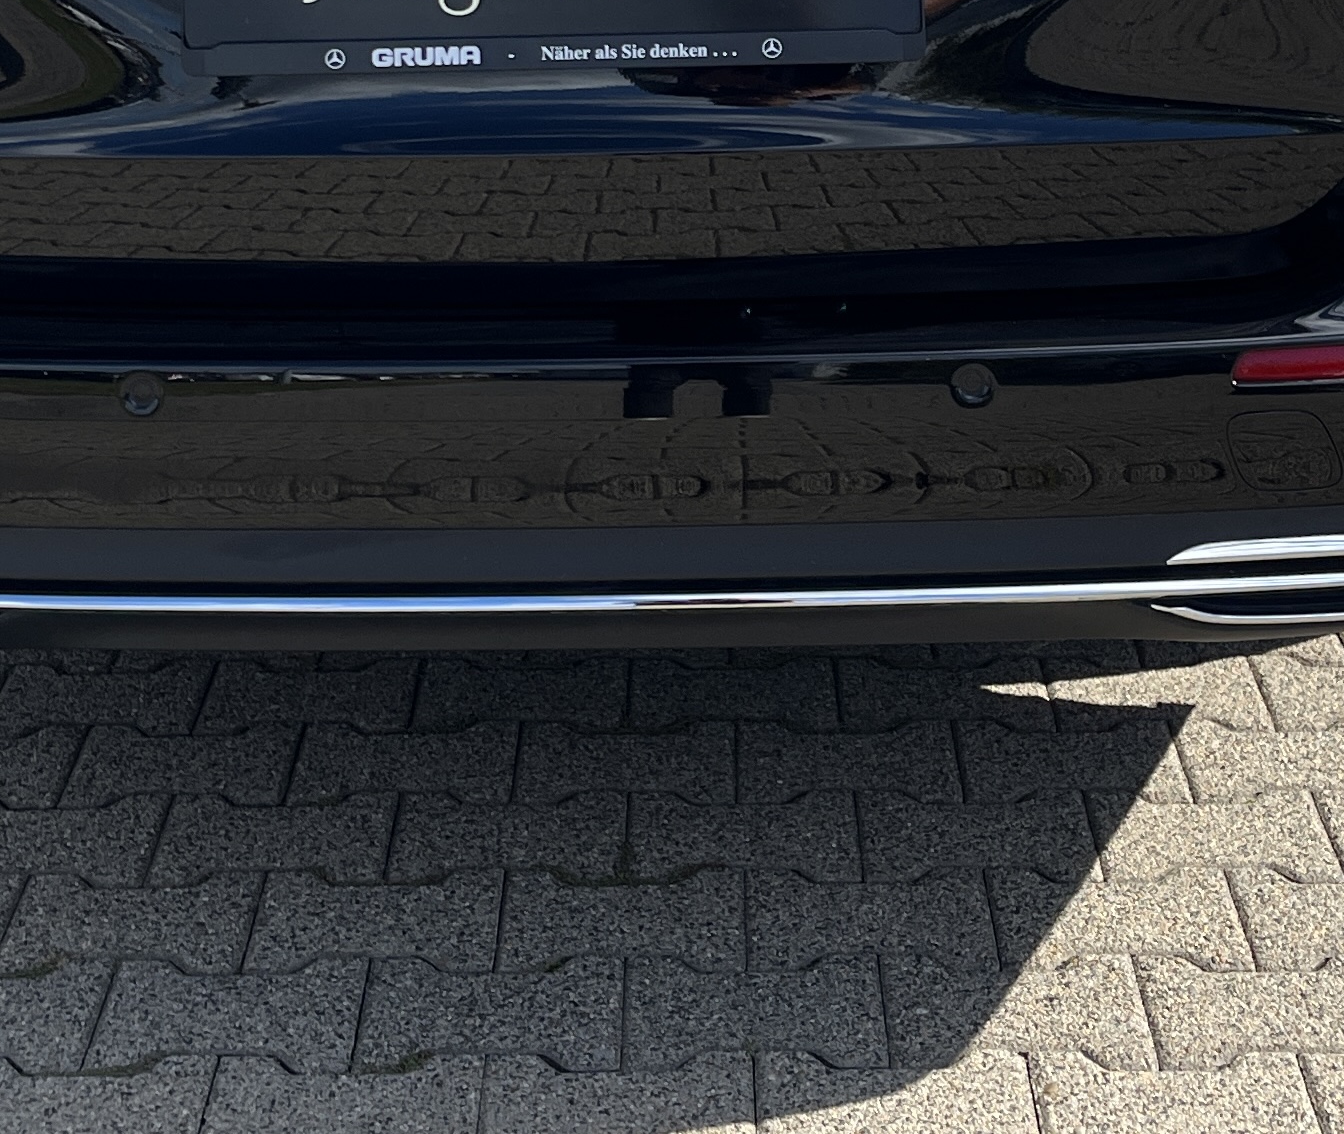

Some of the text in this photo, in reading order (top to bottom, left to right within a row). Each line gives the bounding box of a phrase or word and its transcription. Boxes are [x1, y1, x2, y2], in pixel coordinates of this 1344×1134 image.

[371, 45, 481, 67] GRUMA
[541, 46, 590, 61] Näher
[595, 44, 617, 60] als
[621, 44, 646, 59] Sie
[650, 43, 707, 58] denken
